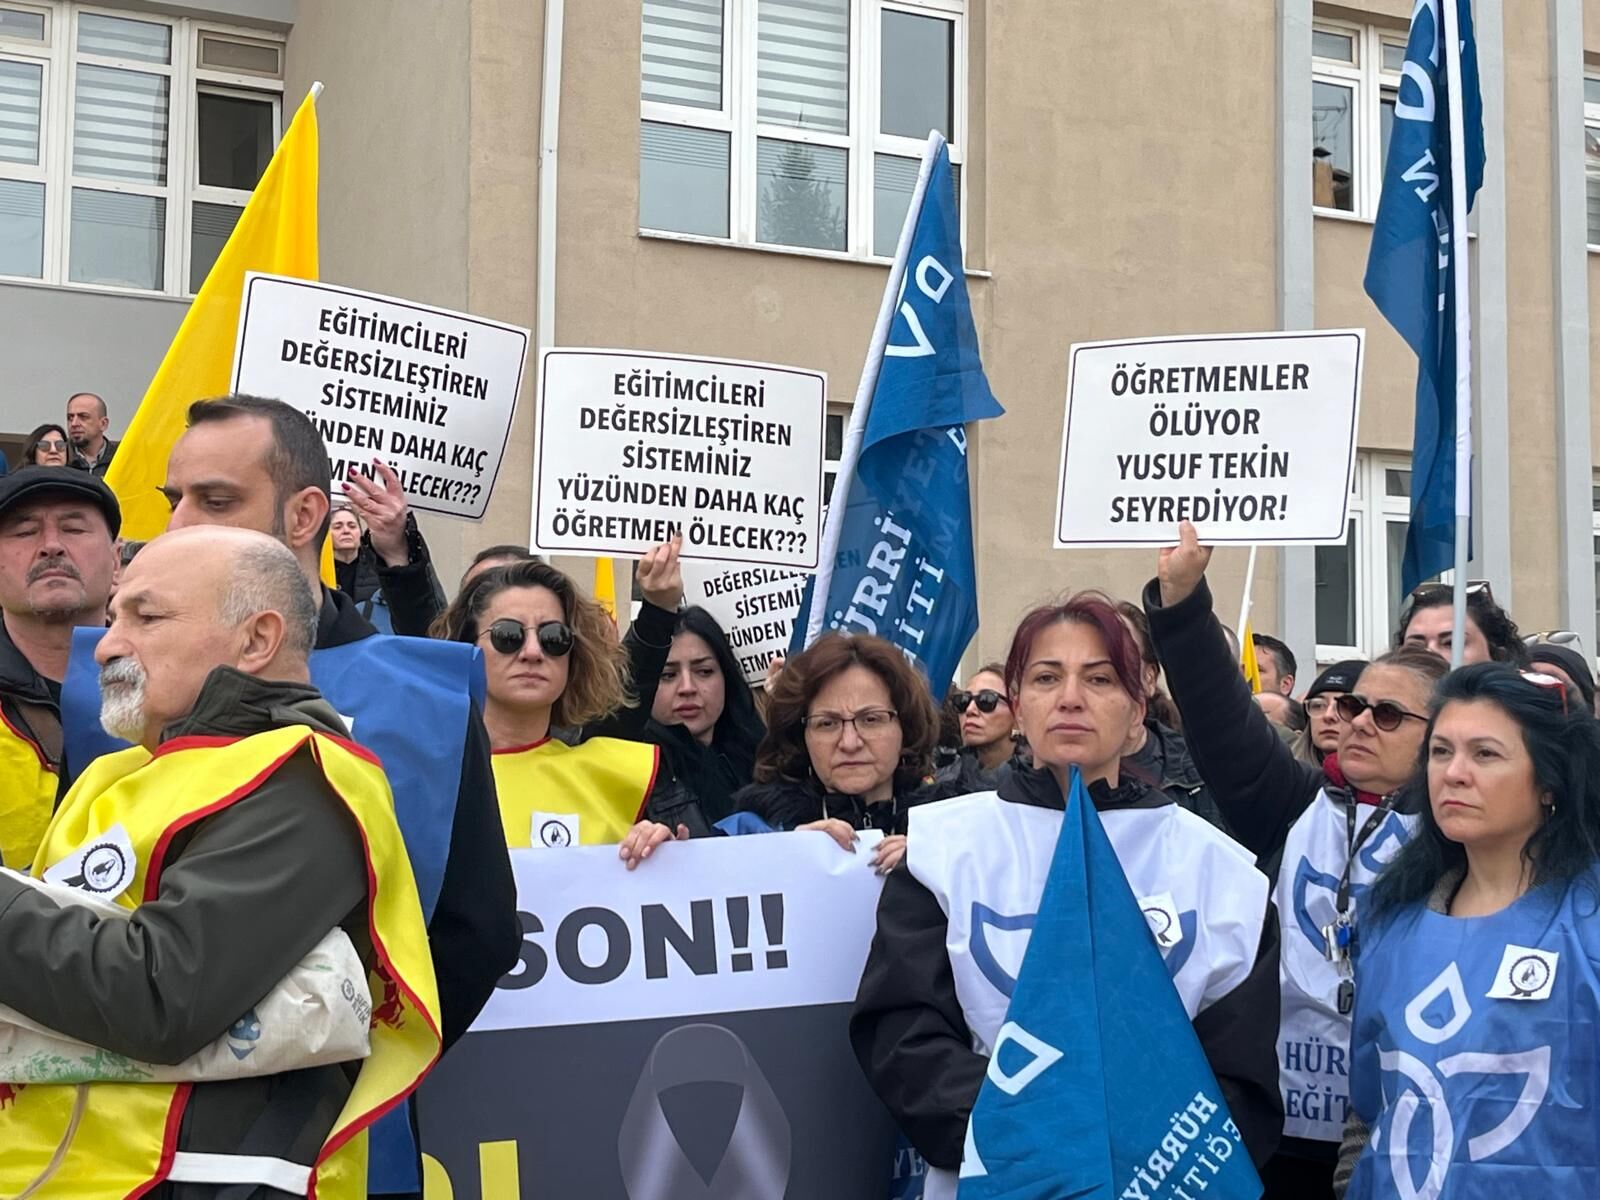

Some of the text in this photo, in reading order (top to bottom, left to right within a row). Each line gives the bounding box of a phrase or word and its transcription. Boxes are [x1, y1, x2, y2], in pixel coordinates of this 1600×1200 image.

[318, 305, 468, 360] EĞİTİMCİLERİ
[280, 339, 489, 400] DEĞERSİZLEŞTİREN
[613, 368, 765, 408] EĞİTİMCİLERİ
[1110, 361, 1310, 396] ÖĞRETMENLER
[320, 379, 448, 427] SİSTEMİNİZ
[580, 403, 792, 446] DEĞERSİZLEŞTİREN
[1150, 402, 1261, 437] ÖLÜYOR
[390, 431, 446, 464] DAHA
[451, 443, 488, 477] KAÇ
[622, 440, 752, 478] SİSTEMİNİZ
[1117, 443, 1289, 480] YUSUF TEKİN
[558, 472, 805, 525] YÜZÜNDEN DAHA KAÇ
[1110, 488, 1288, 523] SEYREDİYOR!
[552, 508, 807, 554] ÖĞRETMEN ÖLECEK???
[735, 583, 805, 619] SİSTEMİ
[494, 892, 789, 990] SON!!
